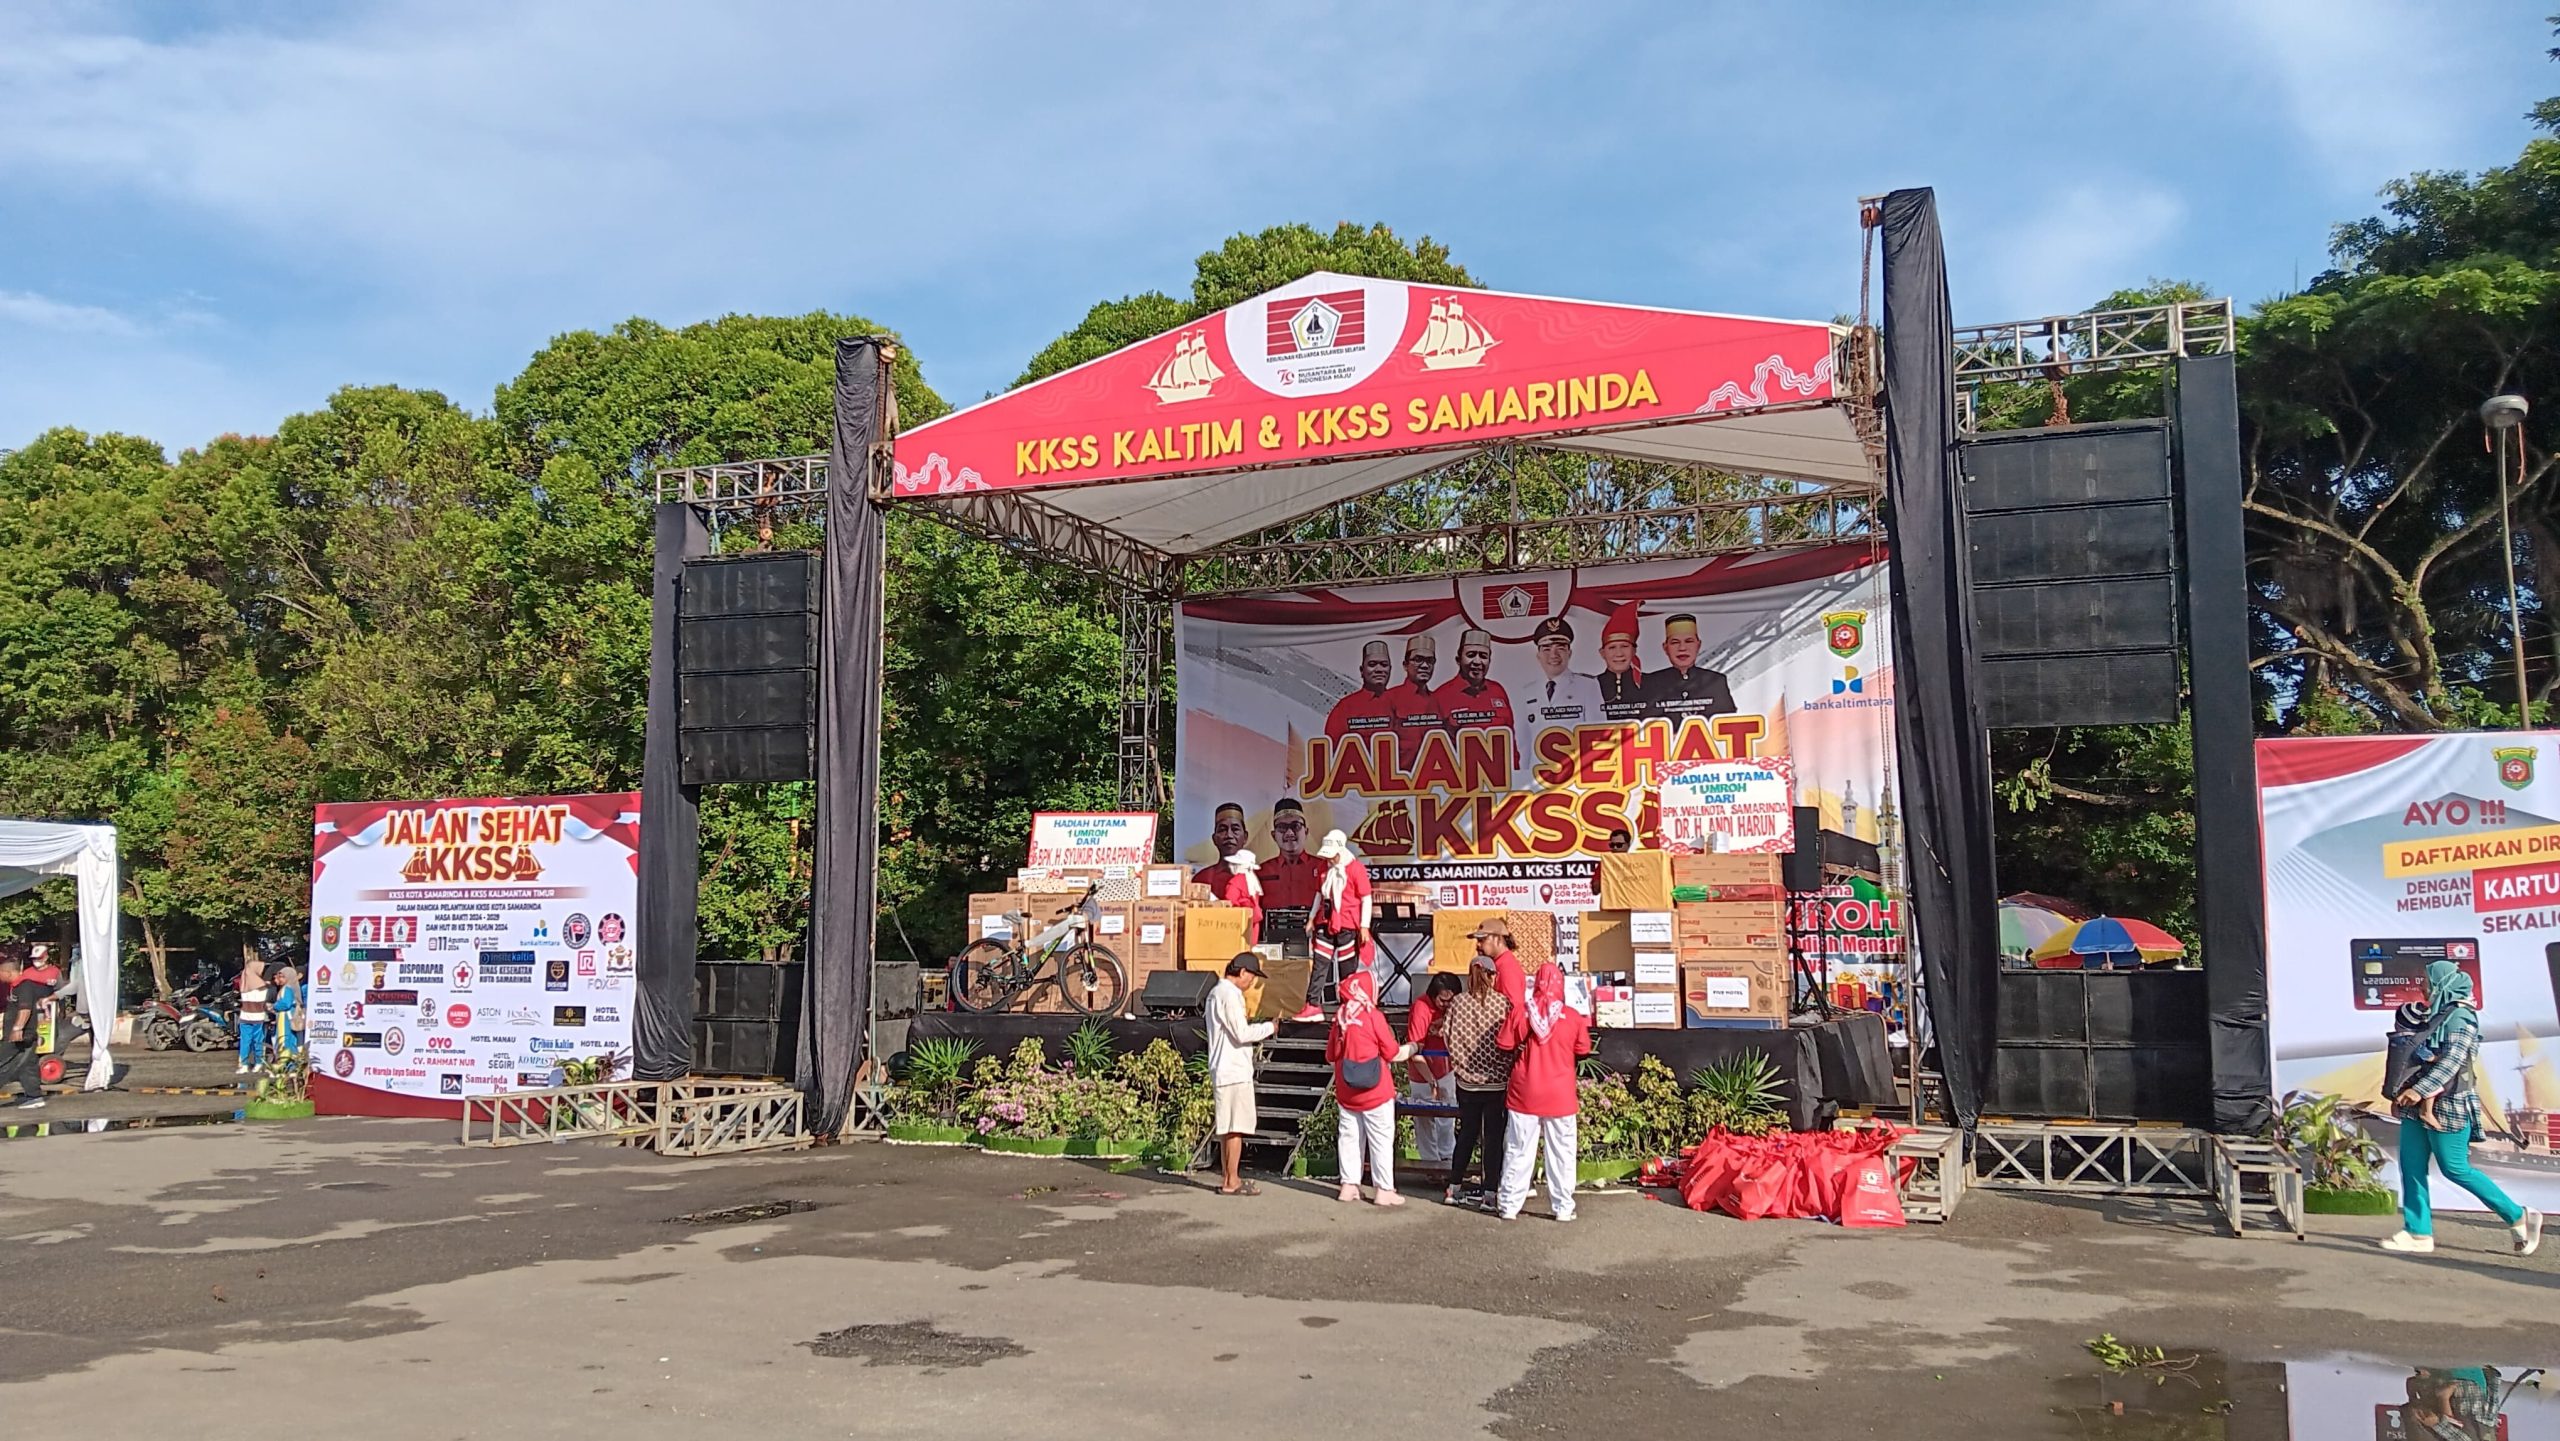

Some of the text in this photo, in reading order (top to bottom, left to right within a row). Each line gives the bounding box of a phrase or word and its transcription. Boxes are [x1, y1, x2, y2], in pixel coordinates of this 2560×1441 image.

[1320, 348, 1344, 357] SULAWESI
[1345, 345, 1365, 354] SELATAN
[1298, 368, 1337, 378] NUSANTARA
[1338, 366, 1356, 375] BARU
[1298, 375, 1333, 384] INDONESIA
[1016, 368, 1659, 477] KKSS KALTIM & KKSS SAMARINDA
[1804, 697, 1894, 711] bankaltimtara
[1302, 719, 1762, 796] JALAN SEHAT
[1671, 771, 1774, 785] HADIAH UTAMA
[1690, 783, 1747, 795] 1 UMROH
[1705, 794, 1735, 804] DARI
[1731, 802, 1788, 815] SAMARINDA
[2403, 800, 2506, 826] AYO !!!
[385, 811, 567, 845] JALAN SEHAT
[1053, 819, 1127, 828] HADIAH UTAMA
[1418, 793, 1632, 859] KKSS
[1737, 815, 1776, 837] HARUN
[1067, 829, 1108, 838] 1 UMROH
[1076, 838, 1100, 846] DARI
[1095, 847, 1140, 864] SARAPPING
[2400, 838, 2523, 868] DAFTARKAN
[431, 846, 513, 881] KKSS
[1383, 866, 1421, 880] KOTA
[1424, 864, 1509, 879] SAMARINDA
[1512, 864, 1523, 877] &
[1529, 864, 1563, 877] KKSS
[1554, 883, 1570, 891] Lap.
[2406, 877, 2471, 895] DENGAN
[2484, 872, 2560, 900] KARTU
[389, 891, 405, 899] KKSS
[470, 890, 488, 898] KKSS
[489, 890, 532, 898] KALIMANTAN
[1459, 884, 1529, 906] 11 Agustus
[507, 903, 542, 911] SAMARINDA
[1482, 896, 1508, 906] 2024
[2397, 893, 2472, 912] MEMBUAT
[1145, 905, 1169, 913] Miyako
[438, 937, 447, 951] 11
[399, 964, 444, 975] DISPORAPAR
[479, 966, 533, 975] DINAS KESEHATAN
[399, 976, 444, 984] KOTA SAMARINDA
[477, 1008, 501, 1017] ASTON
[593, 1015, 620, 1023] GELORA
[428, 1037, 452, 1049] OYO
[554, 1039, 574, 1049] Kaltim
[580, 1040, 602, 1048] HOTEL
[412, 1057, 475, 1066] CV. RAHMAT NUR
[488, 1060, 515, 1069] SEGIRI
[465, 1074, 508, 1084] Samarinda
[494, 1085, 508, 1094] Pos
